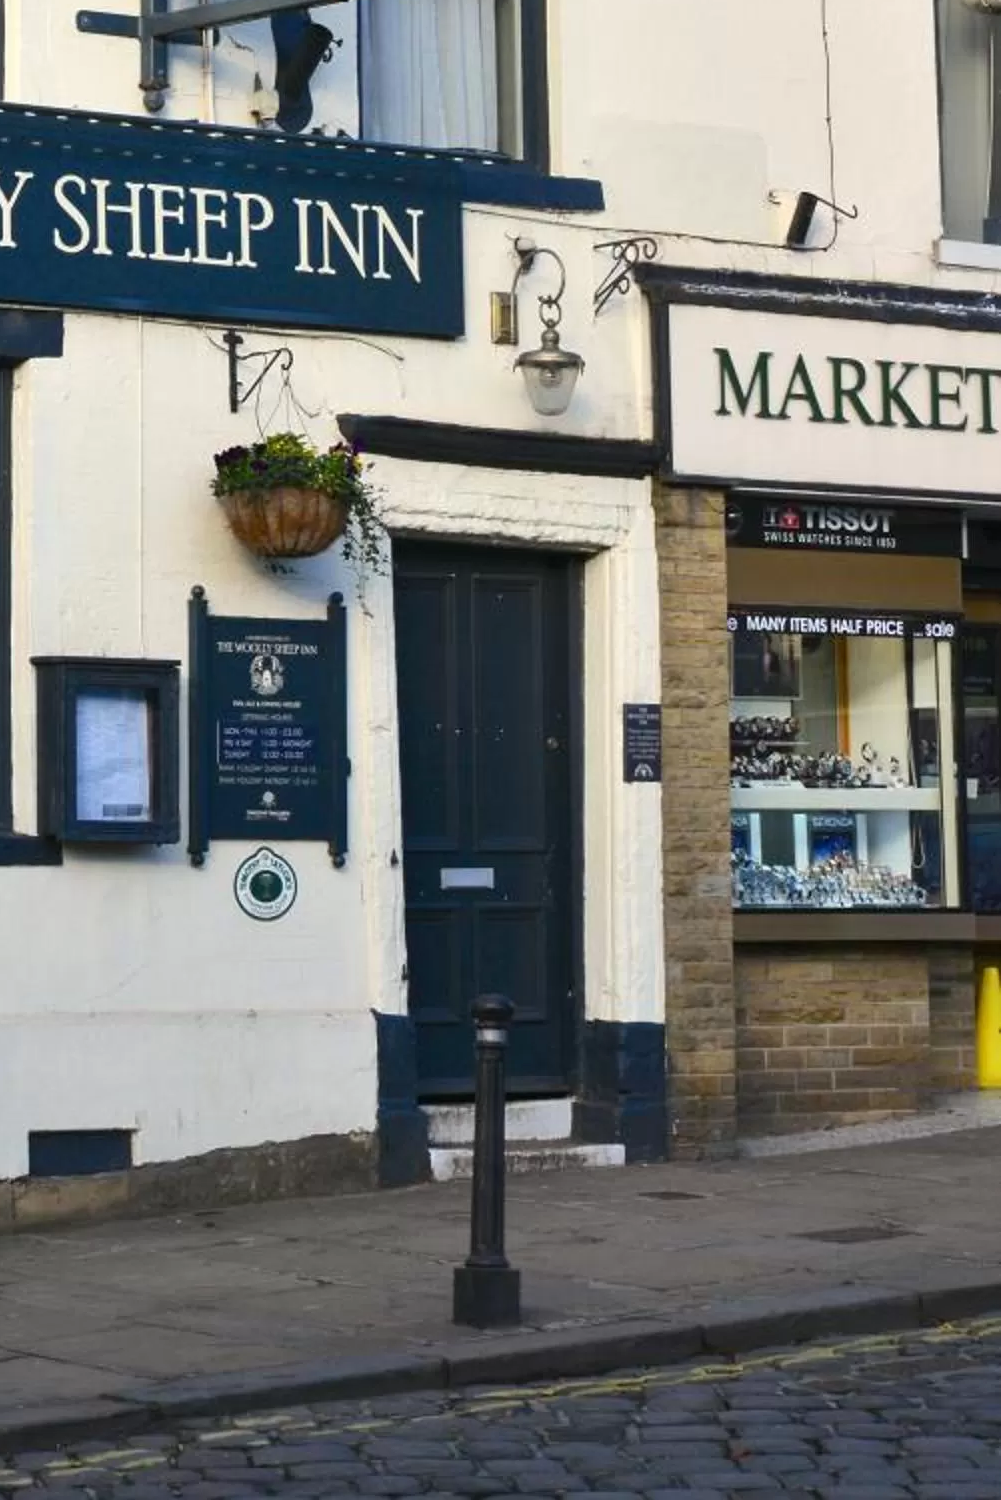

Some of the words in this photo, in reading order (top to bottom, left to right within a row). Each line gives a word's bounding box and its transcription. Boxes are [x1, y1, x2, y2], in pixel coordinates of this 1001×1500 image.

[53, 174, 274, 268] SHEEP
[292, 197, 425, 284] INN
[713, 347, 1001, 435] MARKET
[802, 506, 896, 533] TISSOT
[764, 531, 795, 543] SWISS
[797, 533, 842, 546] WATCHES
[844, 535, 872, 547] SINCE
[747, 616, 787, 632] MANY
[790, 617, 828, 634] ITEMS
[831, 619, 863, 634] HALF
[867, 620, 904, 637] PRICE
